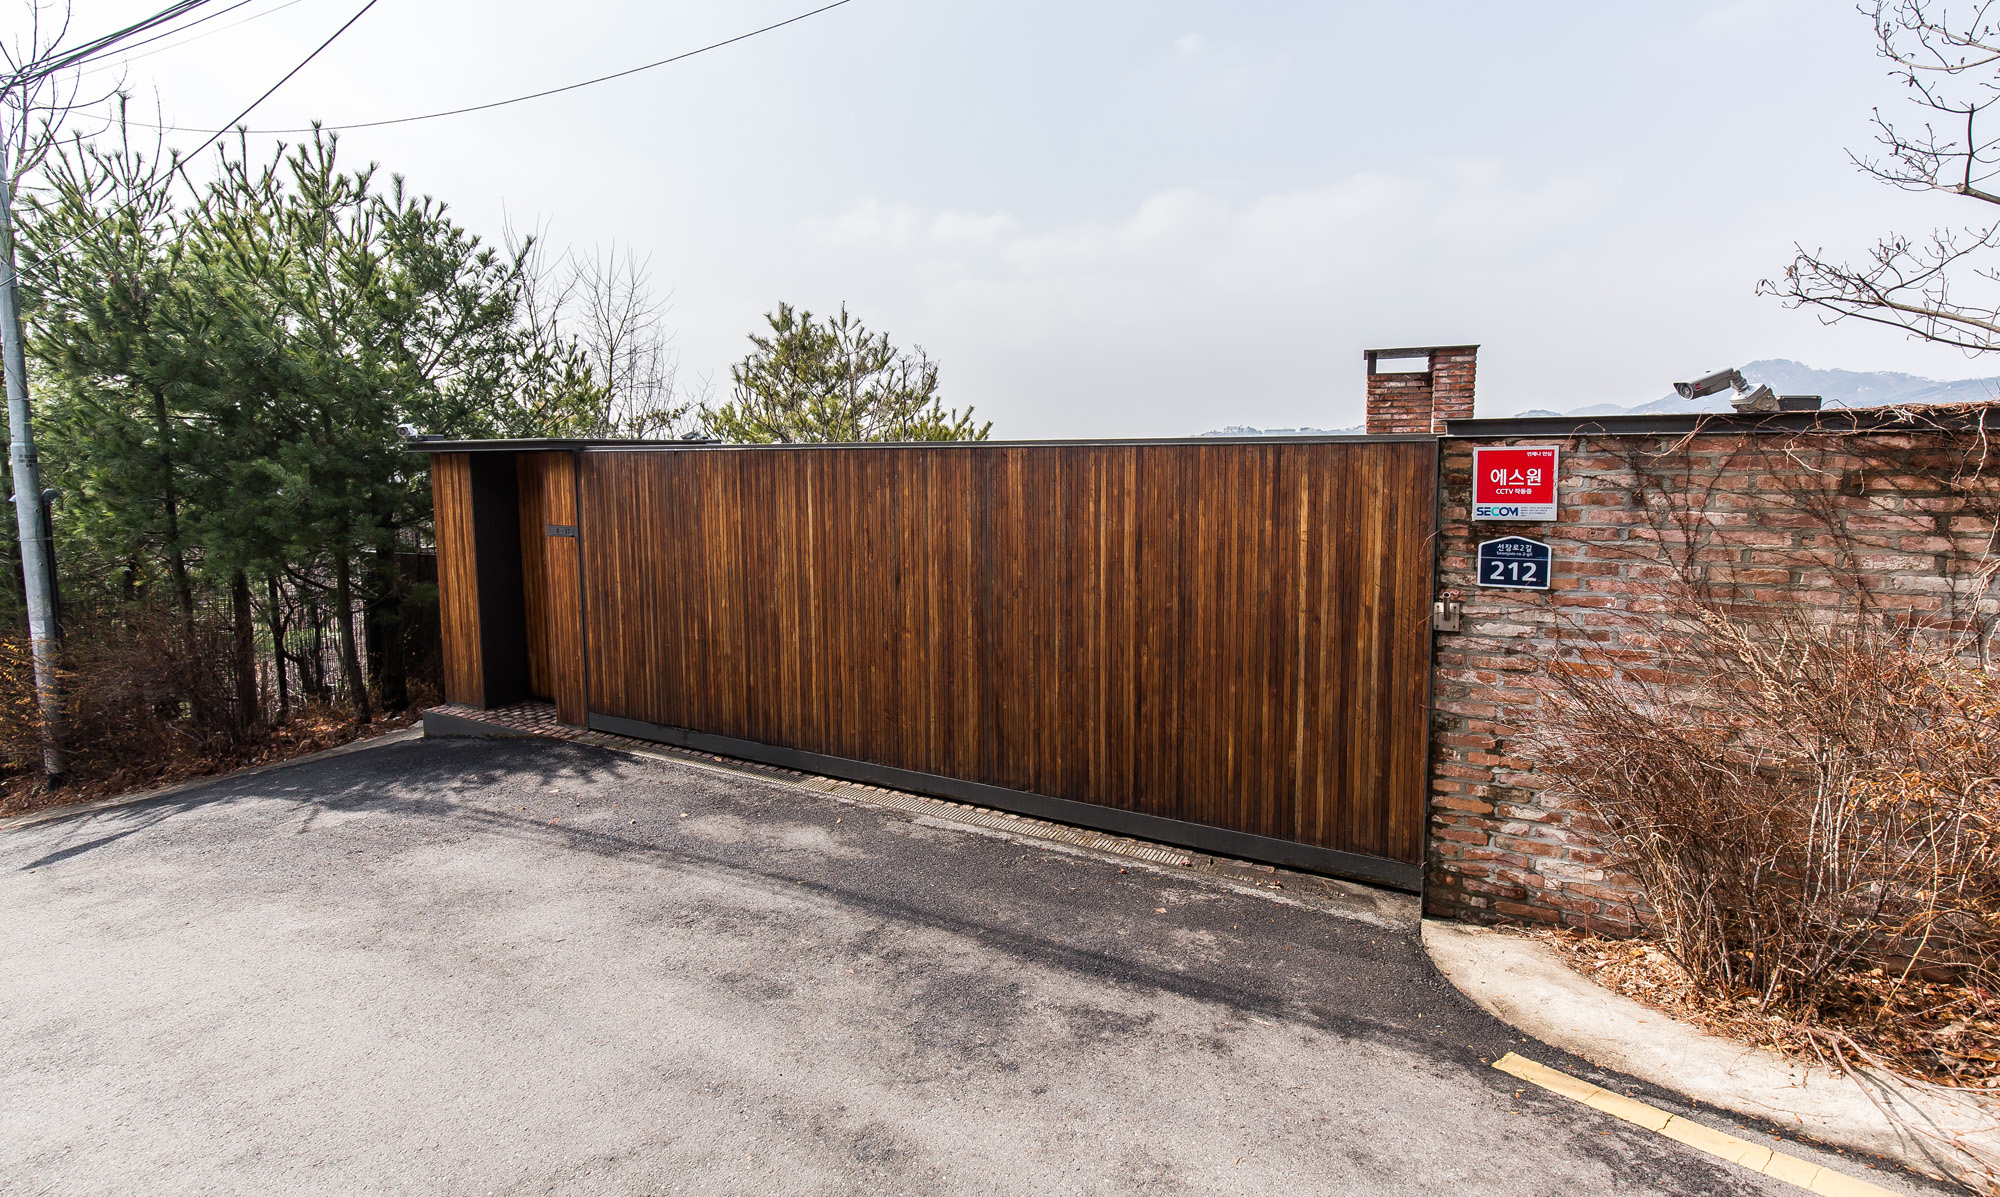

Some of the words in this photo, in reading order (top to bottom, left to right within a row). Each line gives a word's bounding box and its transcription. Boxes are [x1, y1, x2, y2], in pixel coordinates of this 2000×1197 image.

[1490, 468, 1542, 486] 에스원
[1476, 506, 1519, 517] SECOM
[1490, 560, 1537, 582] 212
